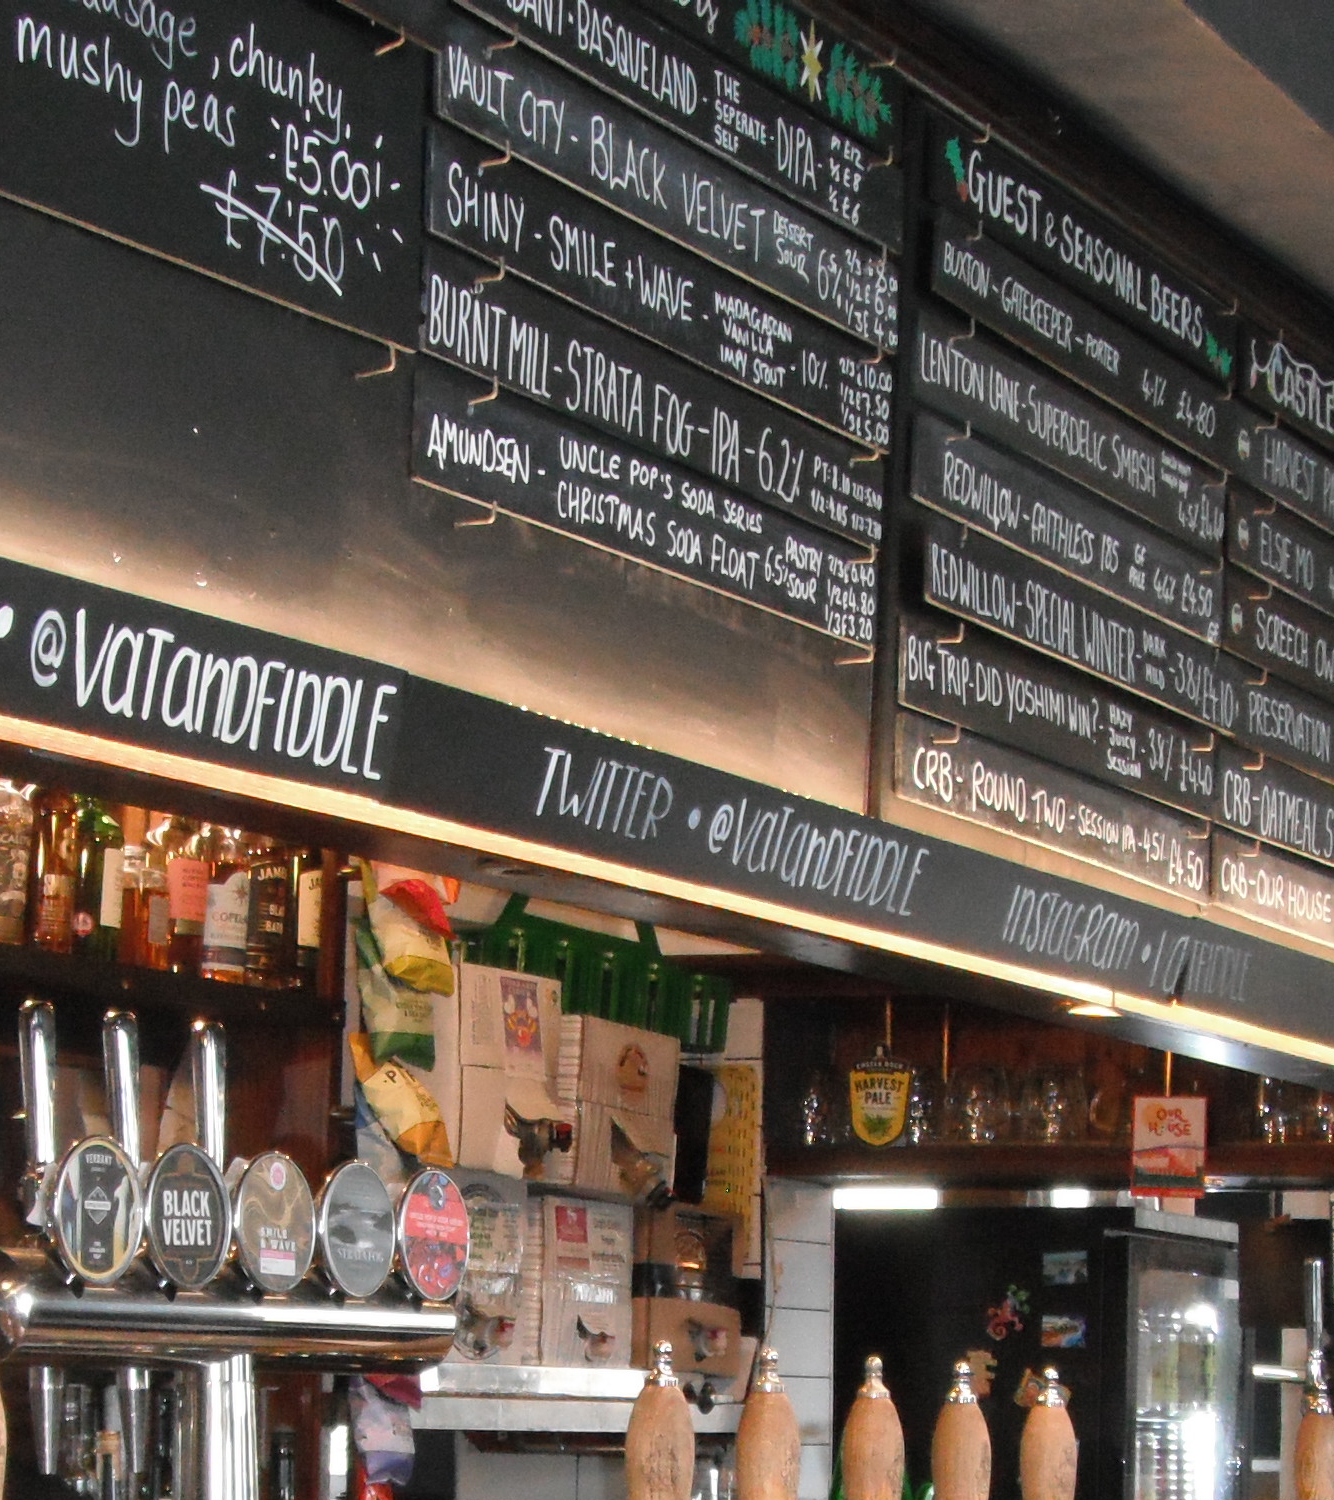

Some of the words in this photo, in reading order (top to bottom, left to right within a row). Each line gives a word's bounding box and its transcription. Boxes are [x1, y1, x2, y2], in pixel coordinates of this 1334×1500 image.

[17, 17, 143, 147] mushy
[165, 79, 236, 153] peas
[577, 0, 698, 115] BASQUELAND
[715, 70, 741, 104] THE
[448, 46, 514, 121] VAULT
[520, 90, 565, 154] CITY
[591, 115, 667, 209] BLACK
[682, 172, 766, 262] VELVET
[714, 124, 739, 153] SELF
[715, 99, 768, 145] SEPERATE
[778, 117, 817, 191] DIPA
[447, 161, 525, 252] SHINY
[550, 215, 616, 287] SMILE
[638, 254, 694, 321] WAVE
[774, 210, 815, 251] DESSERT
[776, 238, 809, 284] SOUR
[968, 149, 1043, 242] GUEST
[1059, 214, 1148, 313] SEASONAL
[1150, 272, 1204, 349] BEERS
[722, 317, 773, 359] VANILLA
[943, 240, 992, 300] BUXTON
[1000, 276, 1074, 354] GATEKEEPER
[1085, 332, 1121, 376] PORTER
[429, 273, 507, 371] BURNT
[509, 315, 552, 399] MILL
[566, 339, 644, 437] STRATA
[652, 383, 695, 458] FOG
[710, 406, 740, 483] IPA
[753, 358, 786, 388] STOUT
[920, 331, 985, 396] LENTON
[988, 364, 1020, 425] LANE
[1027, 383, 1108, 474] SUPERDELIC
[1112, 435, 1157, 499] SMASH
[427, 413, 530, 485] AMUNDSEN
[560, 436, 621, 480] UNCLE
[630, 459, 674, 500] POP'S
[681, 480, 716, 519] SODA
[723, 499, 763, 534] SERIES
[1263, 430, 1318, 503] HARVEST
[556, 480, 657, 547] CHRISTMAS
[666, 519, 703, 565] SODA
[711, 533, 761, 591] FLOAT
[942, 452, 1021, 531] REDWILLOW
[1031, 501, 1096, 566] FAITHLESS
[1100, 534, 1120, 574] 185
[786, 536, 823, 578] PASTRY
[787, 572, 817, 605] SOUR
[931, 542, 1016, 629] REDWILLOW
[1025, 579, 1080, 660] SPECIAL
[1083, 606, 1136, 684] WINTER
[1255, 607, 1310, 669] SCREECH
[907, 635, 936, 690] BIG
[937, 649, 970, 707] TRIP
[976, 662, 1003, 707] DID
[1006, 671, 1067, 726] YOSHIMI
[1248, 690, 1332, 764] PRESERVATION
[534, 745, 674, 843] TWITTER
[913, 746, 954, 803] CRB
[972, 760, 1027, 823] ROUND
[1031, 789, 1066, 834] TWO
[1078, 804, 1120, 846] SESSION
[1223, 769, 1253, 828] CRB
[1259, 784, 1321, 857] OATMEAL
[1220, 856, 1248, 900] CRB
[1256, 869, 1285, 910] OUR
[1288, 880, 1333, 924] HOUSE
[854, 1076, 906, 1094] HARVEST
[863, 1091, 893, 1106] PALE
[1155, 1107, 1189, 1123] OUR
[162, 1190, 212, 1219] BLACK
[162, 1218, 213, 1248] VELVET
